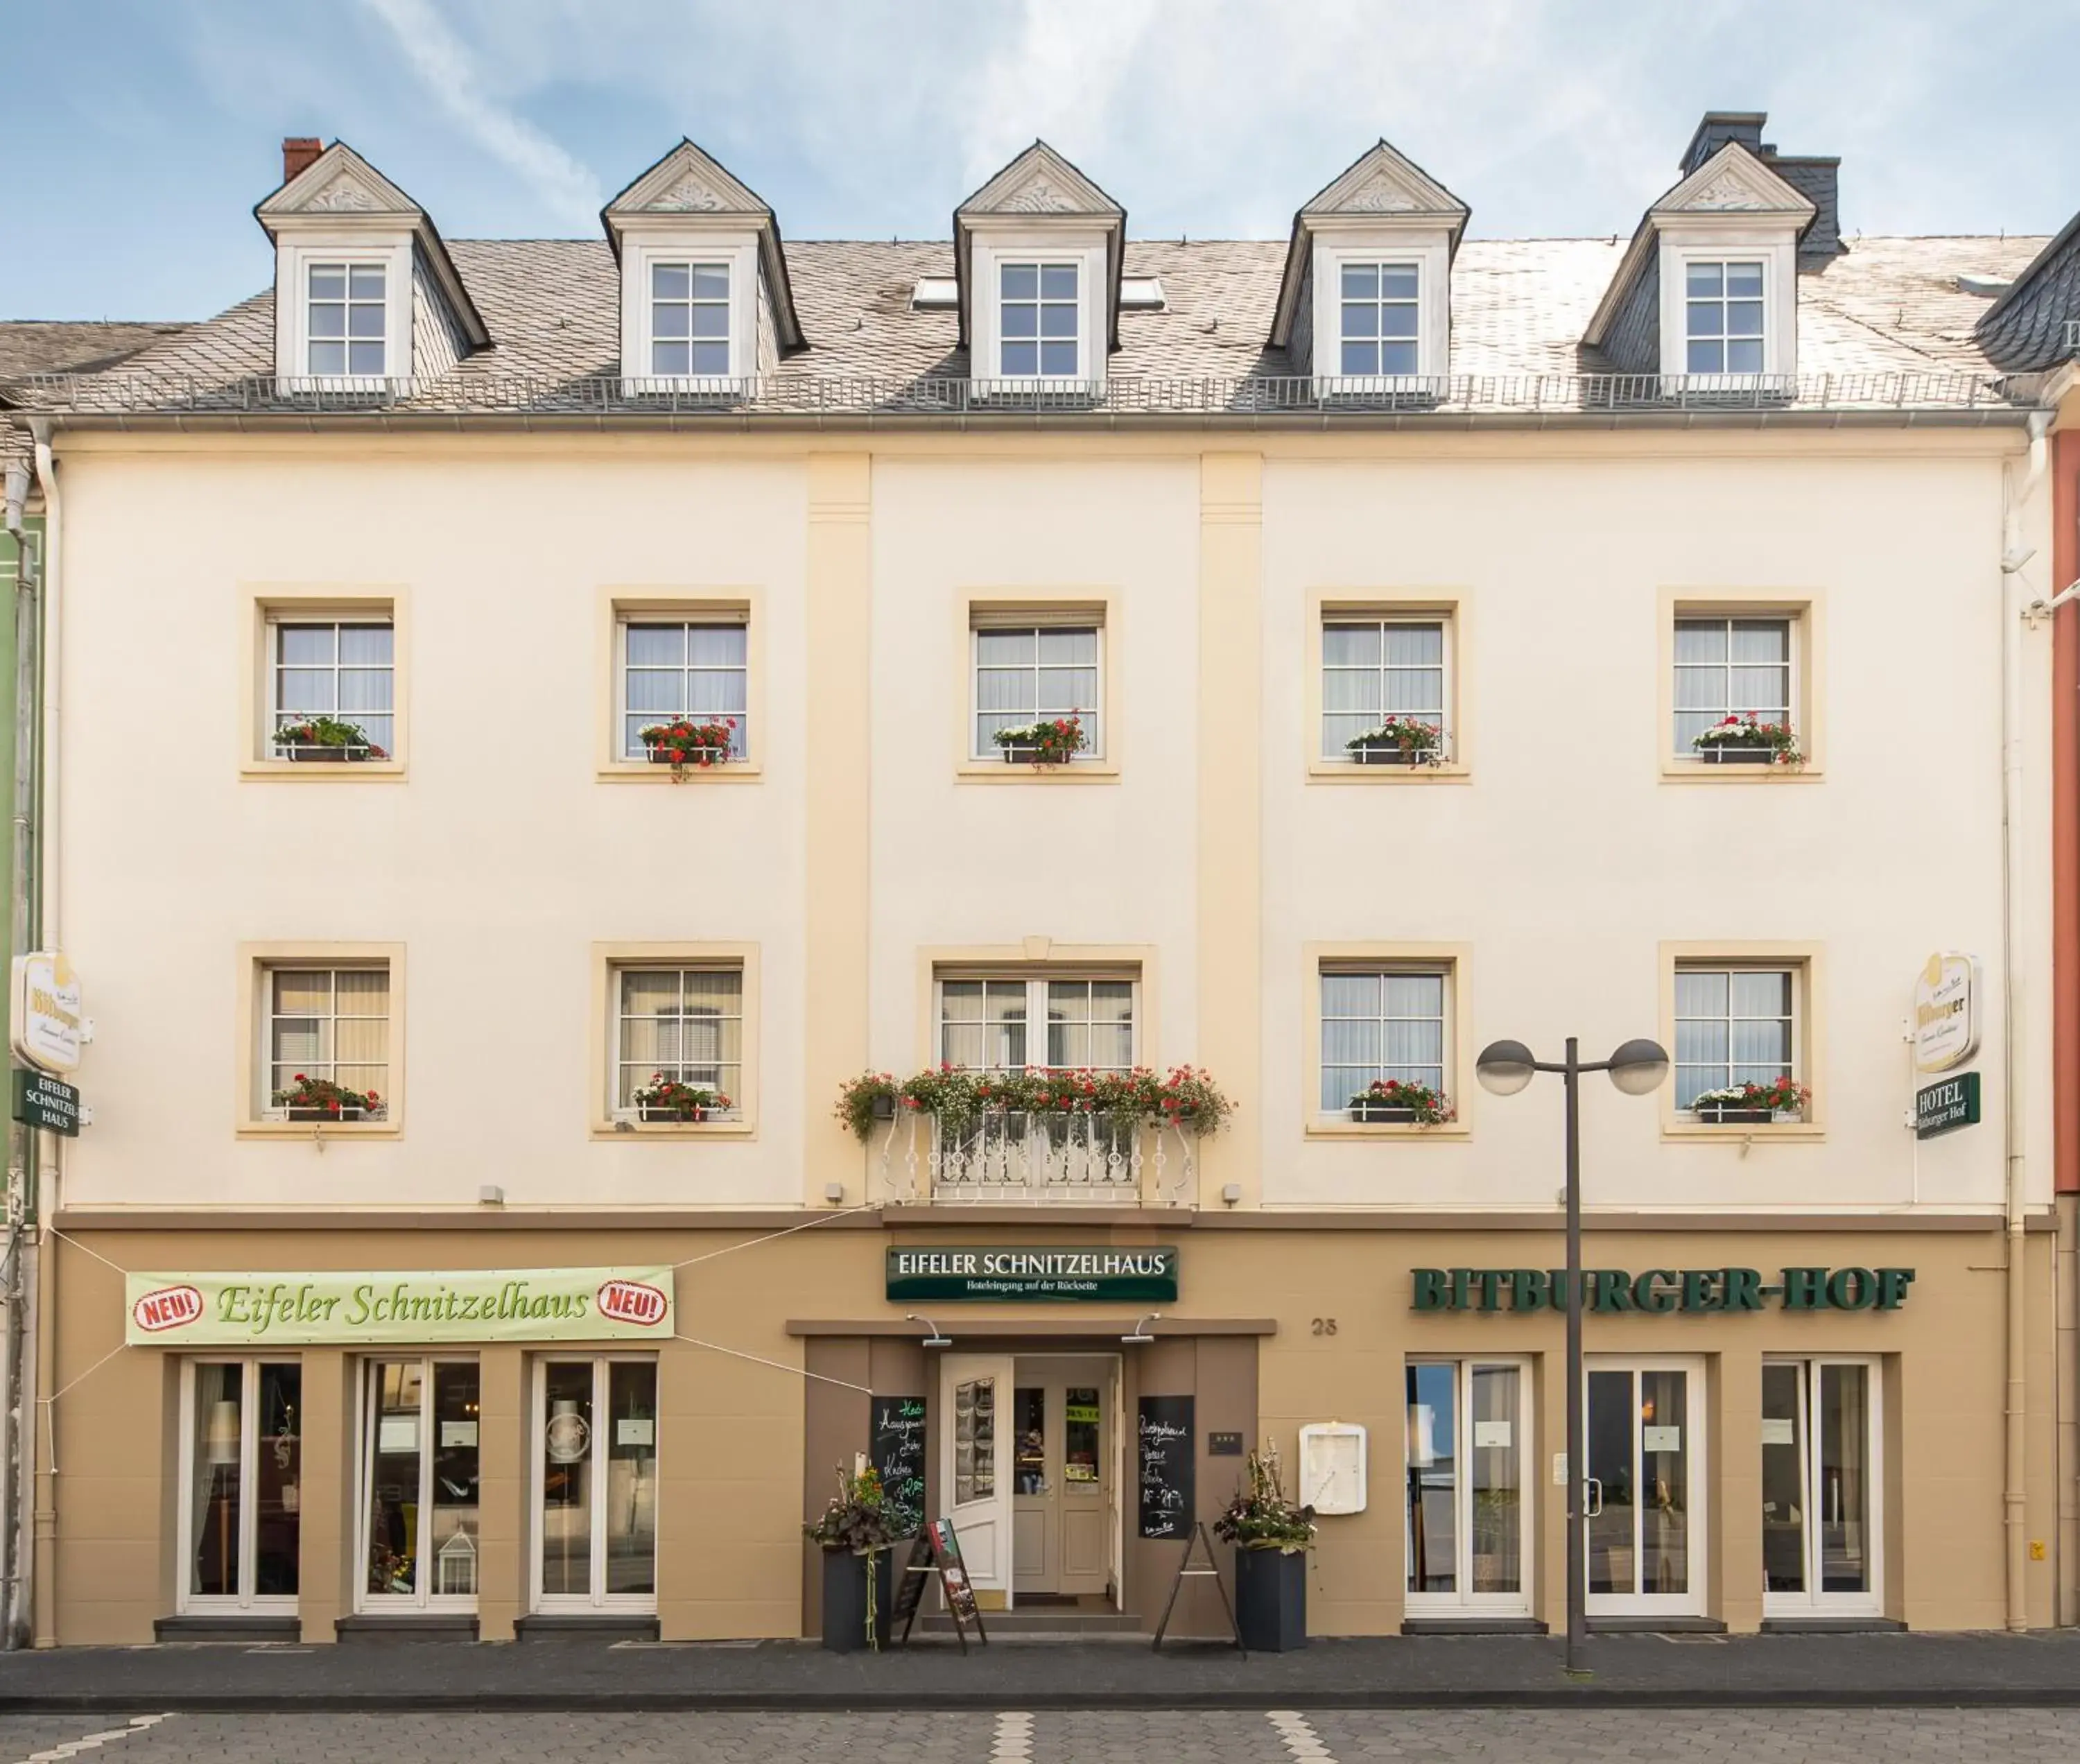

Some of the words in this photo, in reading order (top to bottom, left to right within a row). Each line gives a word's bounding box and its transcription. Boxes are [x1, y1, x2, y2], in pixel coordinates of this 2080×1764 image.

[38, 1078, 71, 1100] EIFELER
[1919, 1082, 1963, 1115] HOTEL
[42, 1109, 69, 1128] HAUS
[1949, 1102, 1967, 1120] Hof
[899, 1254, 976, 1274] EIFELER
[983, 1254, 1165, 1275] SCHNITZELHAUS
[967, 1280, 1023, 1292] Hoteleingang
[1024, 1279, 1039, 1290] auf
[1041, 1281, 1055, 1290] der
[1057, 1280, 1098, 1290] Rückseite
[1409, 1267, 1916, 1313] BITBURGER-HOF
[143, 1292, 196, 1326] NEU!
[217, 1283, 340, 1334] Eifeler
[345, 1280, 589, 1325] Schnitzelhaus
[606, 1286, 658, 1319] NEU!
